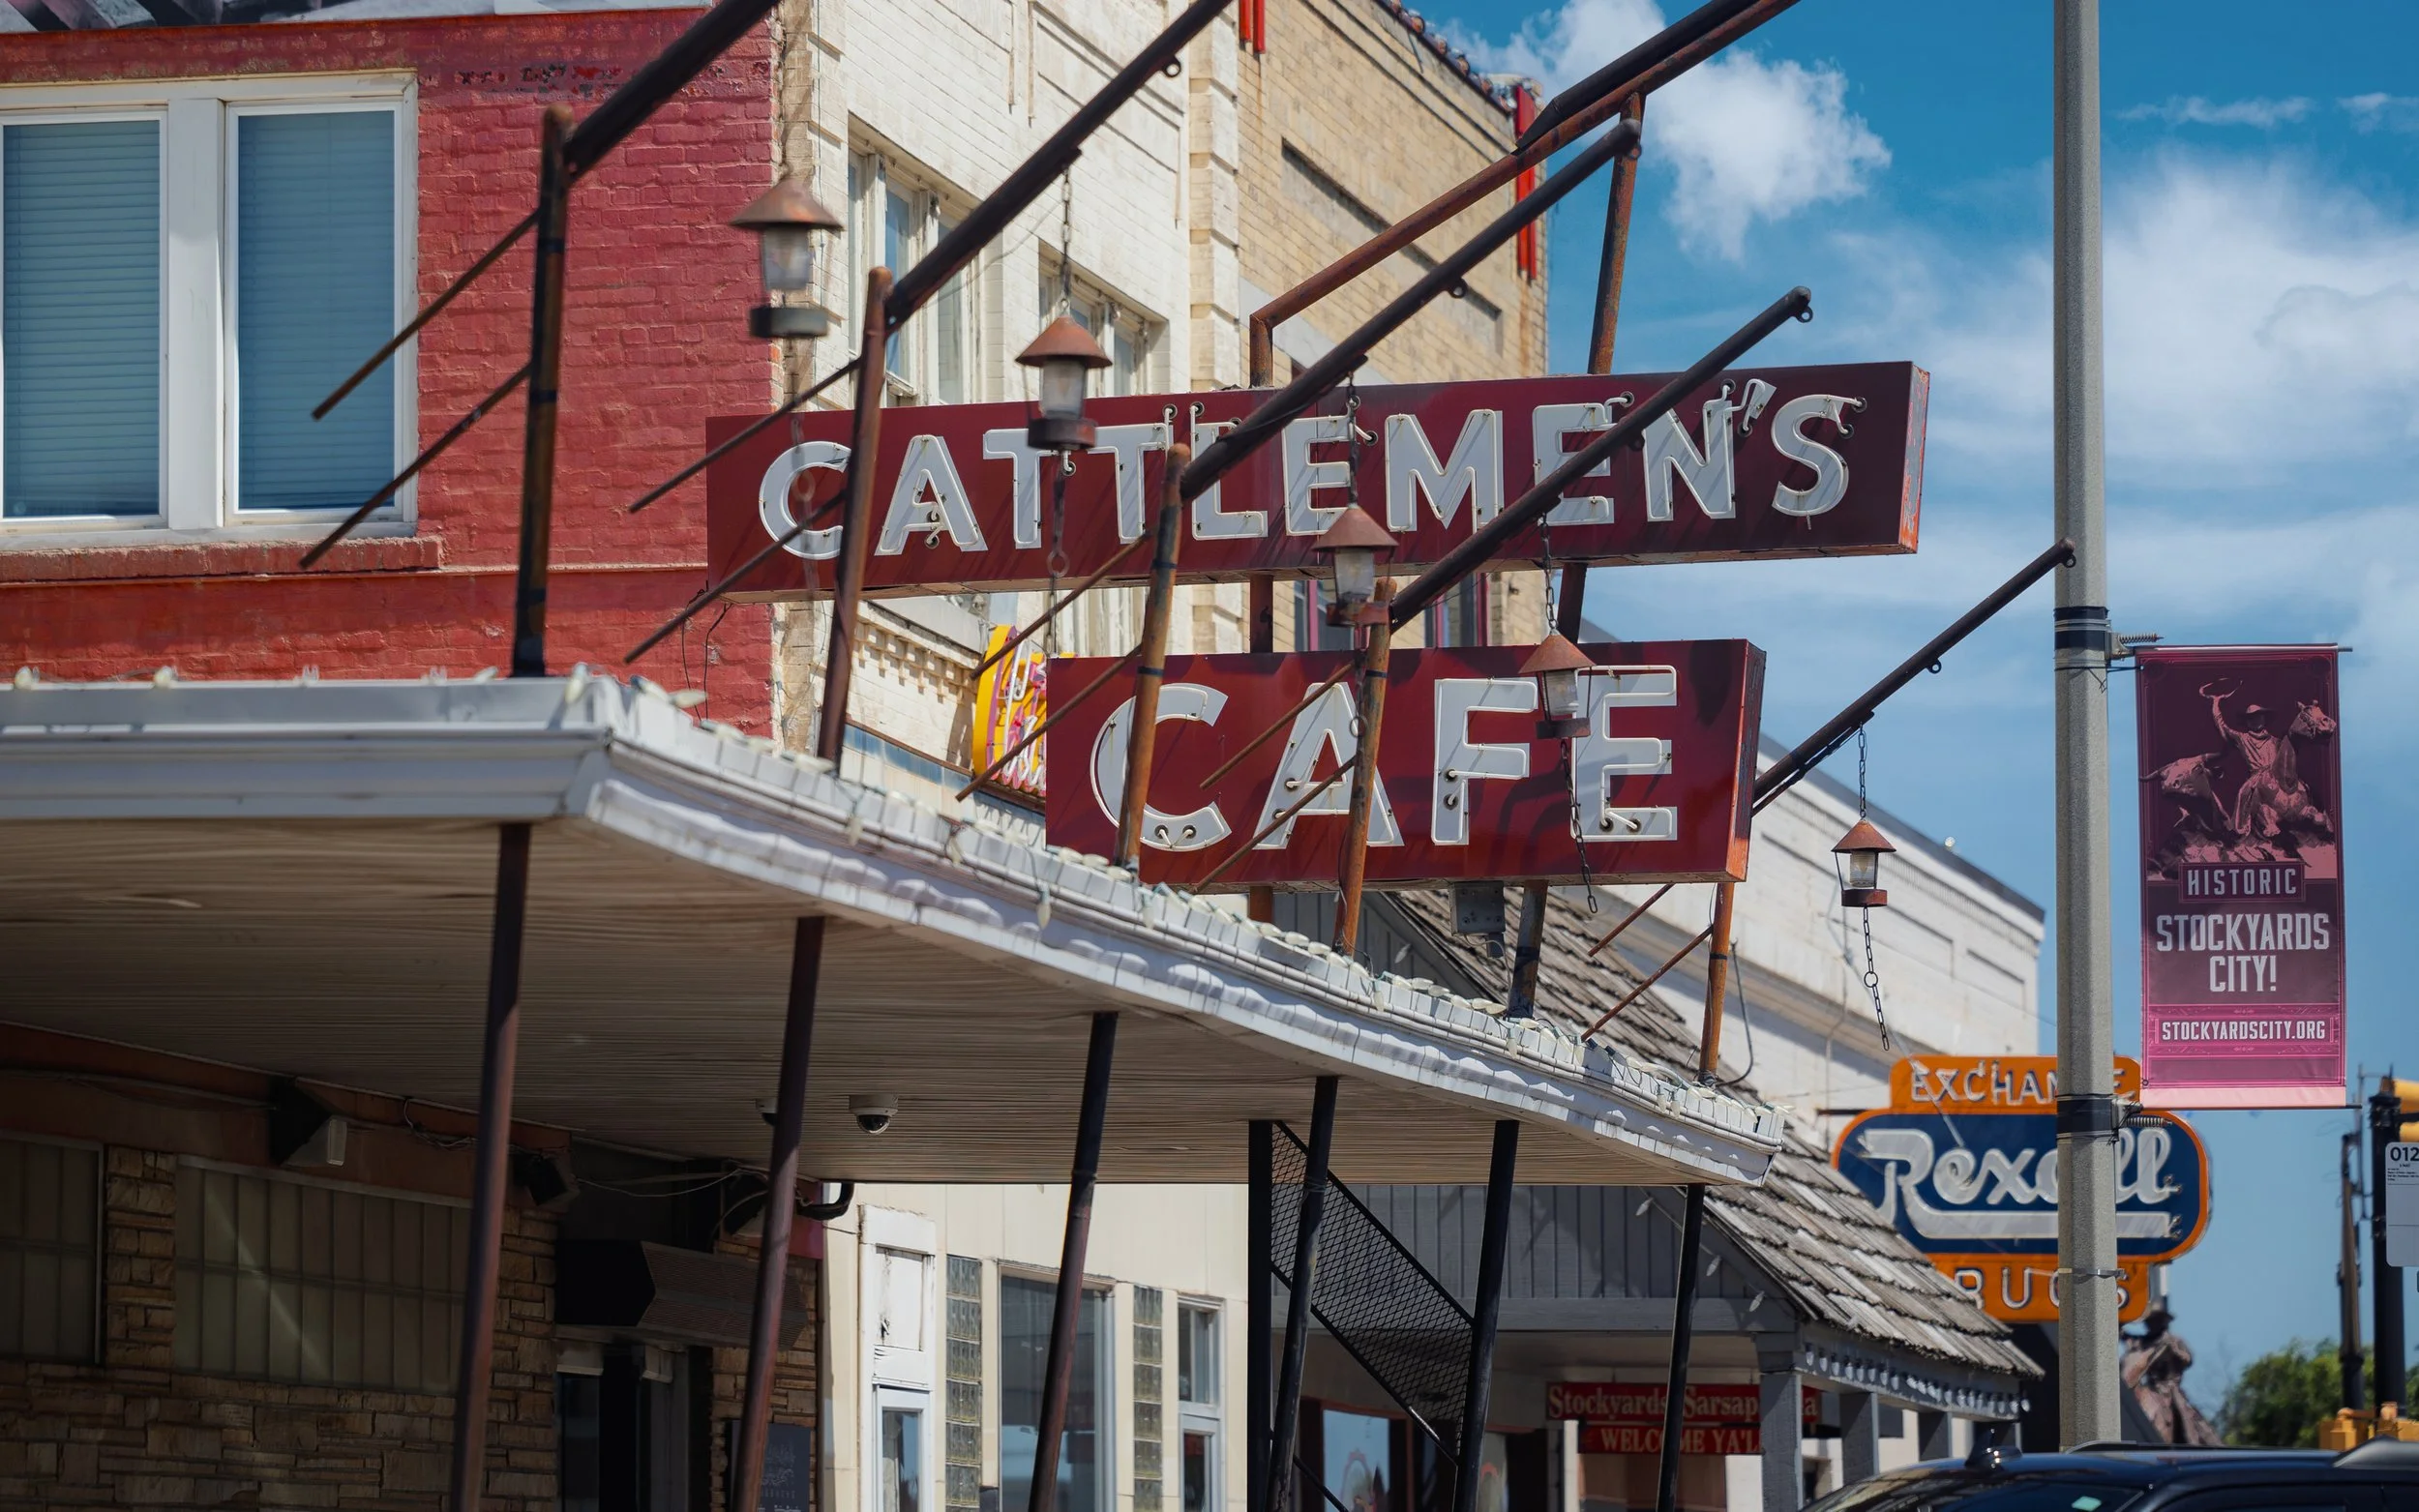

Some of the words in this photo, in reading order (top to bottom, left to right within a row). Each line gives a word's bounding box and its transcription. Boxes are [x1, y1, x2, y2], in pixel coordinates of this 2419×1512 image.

[759, 378, 1852, 560] CATTLEMEN'S
[1090, 665, 1678, 852] CAFE
[2188, 868, 2297, 896] HISTORIC
[2156, 913, 2330, 952] STOCKYARDS
[2209, 955, 2277, 993] CITY!
[2162, 1020, 2326, 1041] STOCKYARDSCITY.ORG
[1911, 1061, 2135, 1107] EXCHANE
[1600, 1428, 1705, 1453] WELCME
[1712, 1428, 1762, 1453] YA'L
